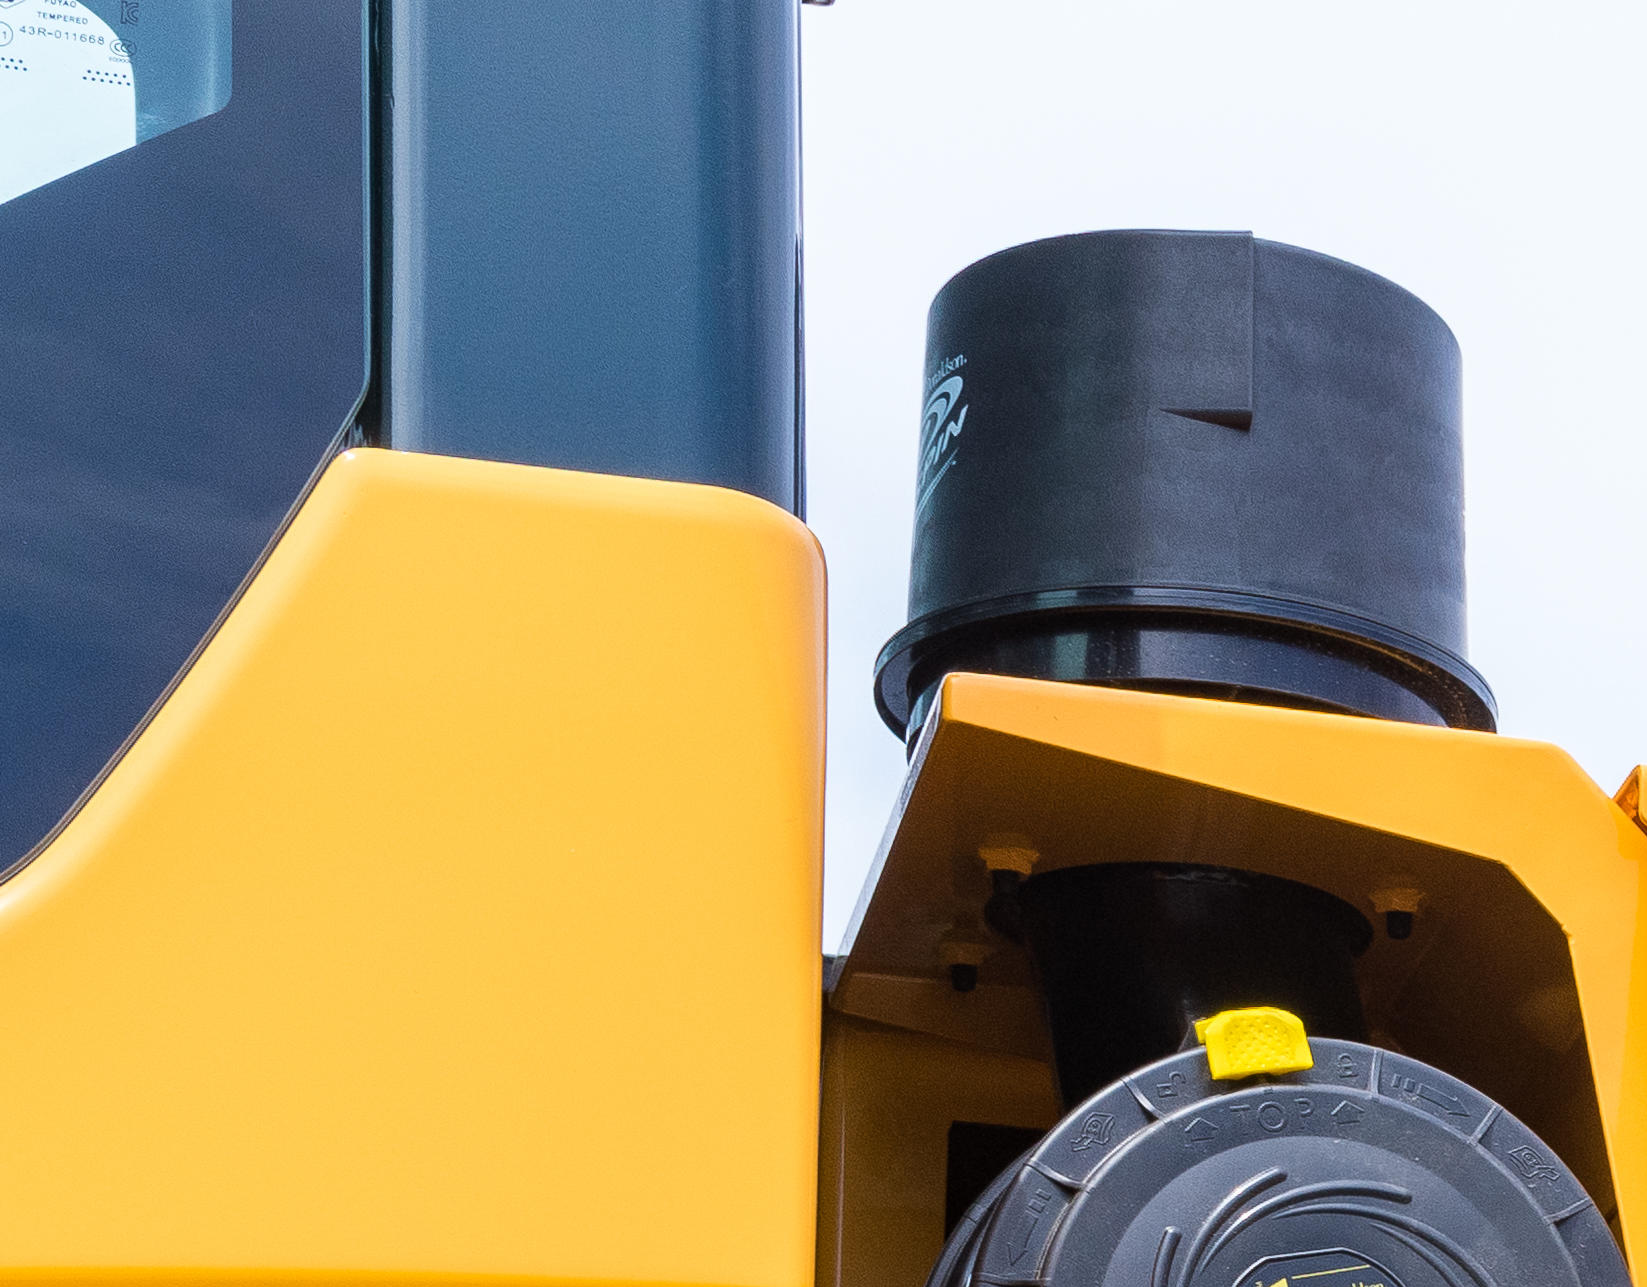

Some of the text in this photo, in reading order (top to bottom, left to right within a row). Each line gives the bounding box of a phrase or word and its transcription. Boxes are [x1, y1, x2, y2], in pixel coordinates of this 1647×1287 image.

[37, 11, 88, 25] TEMPERED
[19, 26, 105, 45] 43R-011668
[1229, 1098, 1315, 1134] TOP
